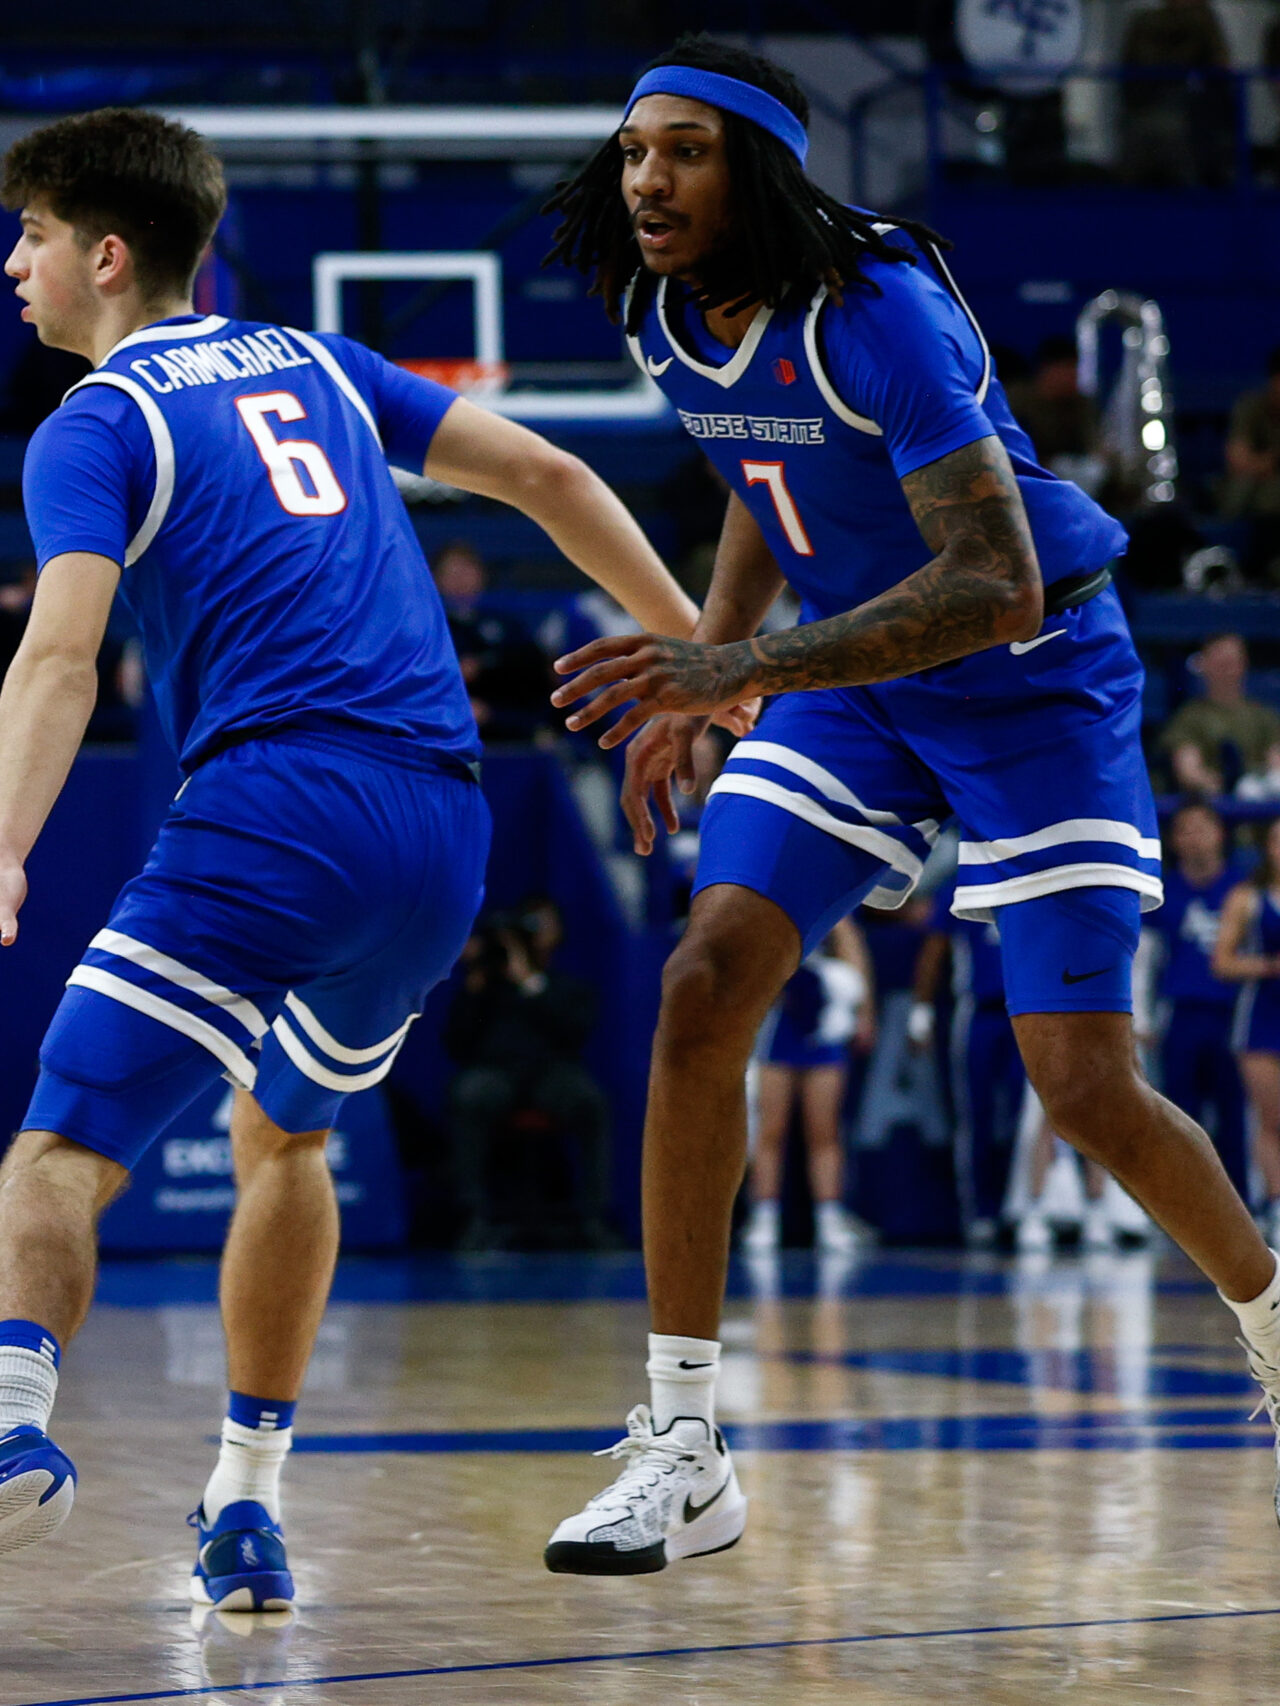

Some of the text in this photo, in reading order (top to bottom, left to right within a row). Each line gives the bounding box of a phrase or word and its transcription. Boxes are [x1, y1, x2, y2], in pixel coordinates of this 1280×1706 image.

[130, 327, 314, 394] CARMICHAEL
[233, 389, 349, 517] 6
[745, 415, 826, 445] STATE
[740, 459, 816, 557] 7
